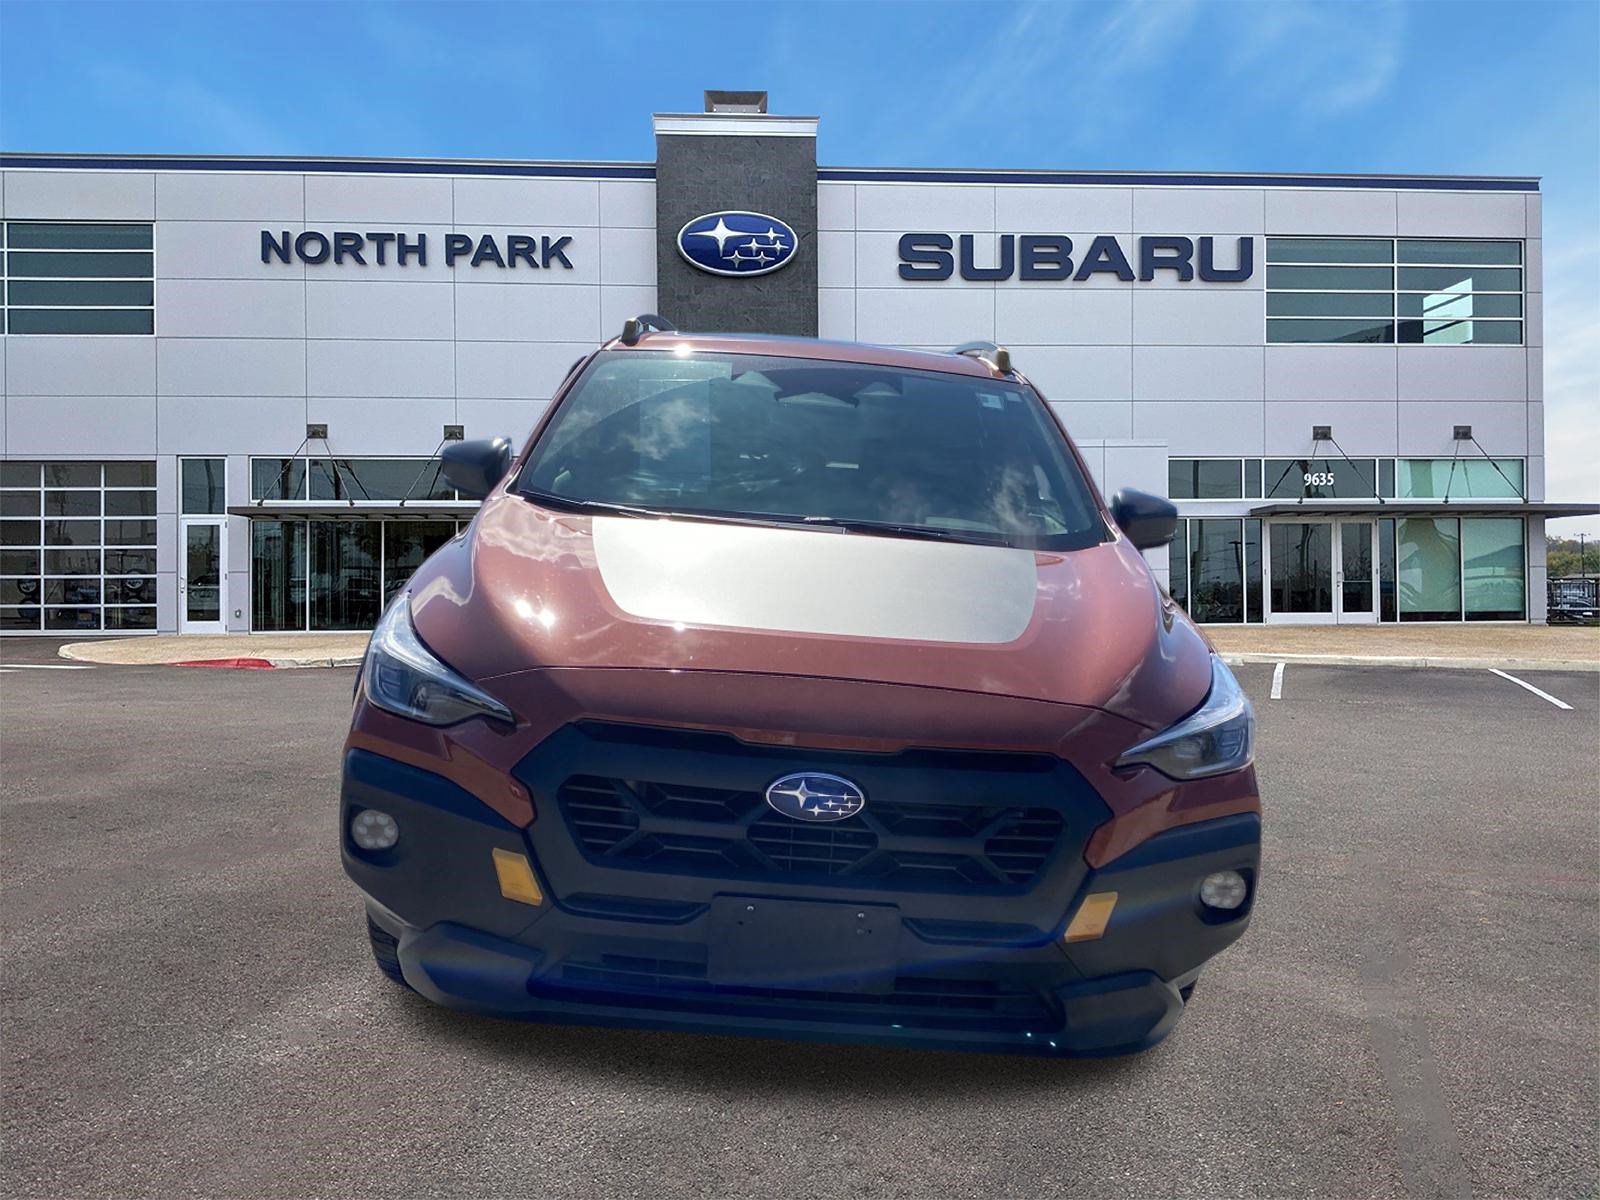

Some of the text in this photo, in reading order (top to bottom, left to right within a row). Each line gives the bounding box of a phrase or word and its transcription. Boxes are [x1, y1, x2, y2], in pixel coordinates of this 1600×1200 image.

[260, 230, 574, 269] NORTH PARK
[898, 233, 1254, 282] SUBARU
[1303, 472, 1334, 486] 9635
